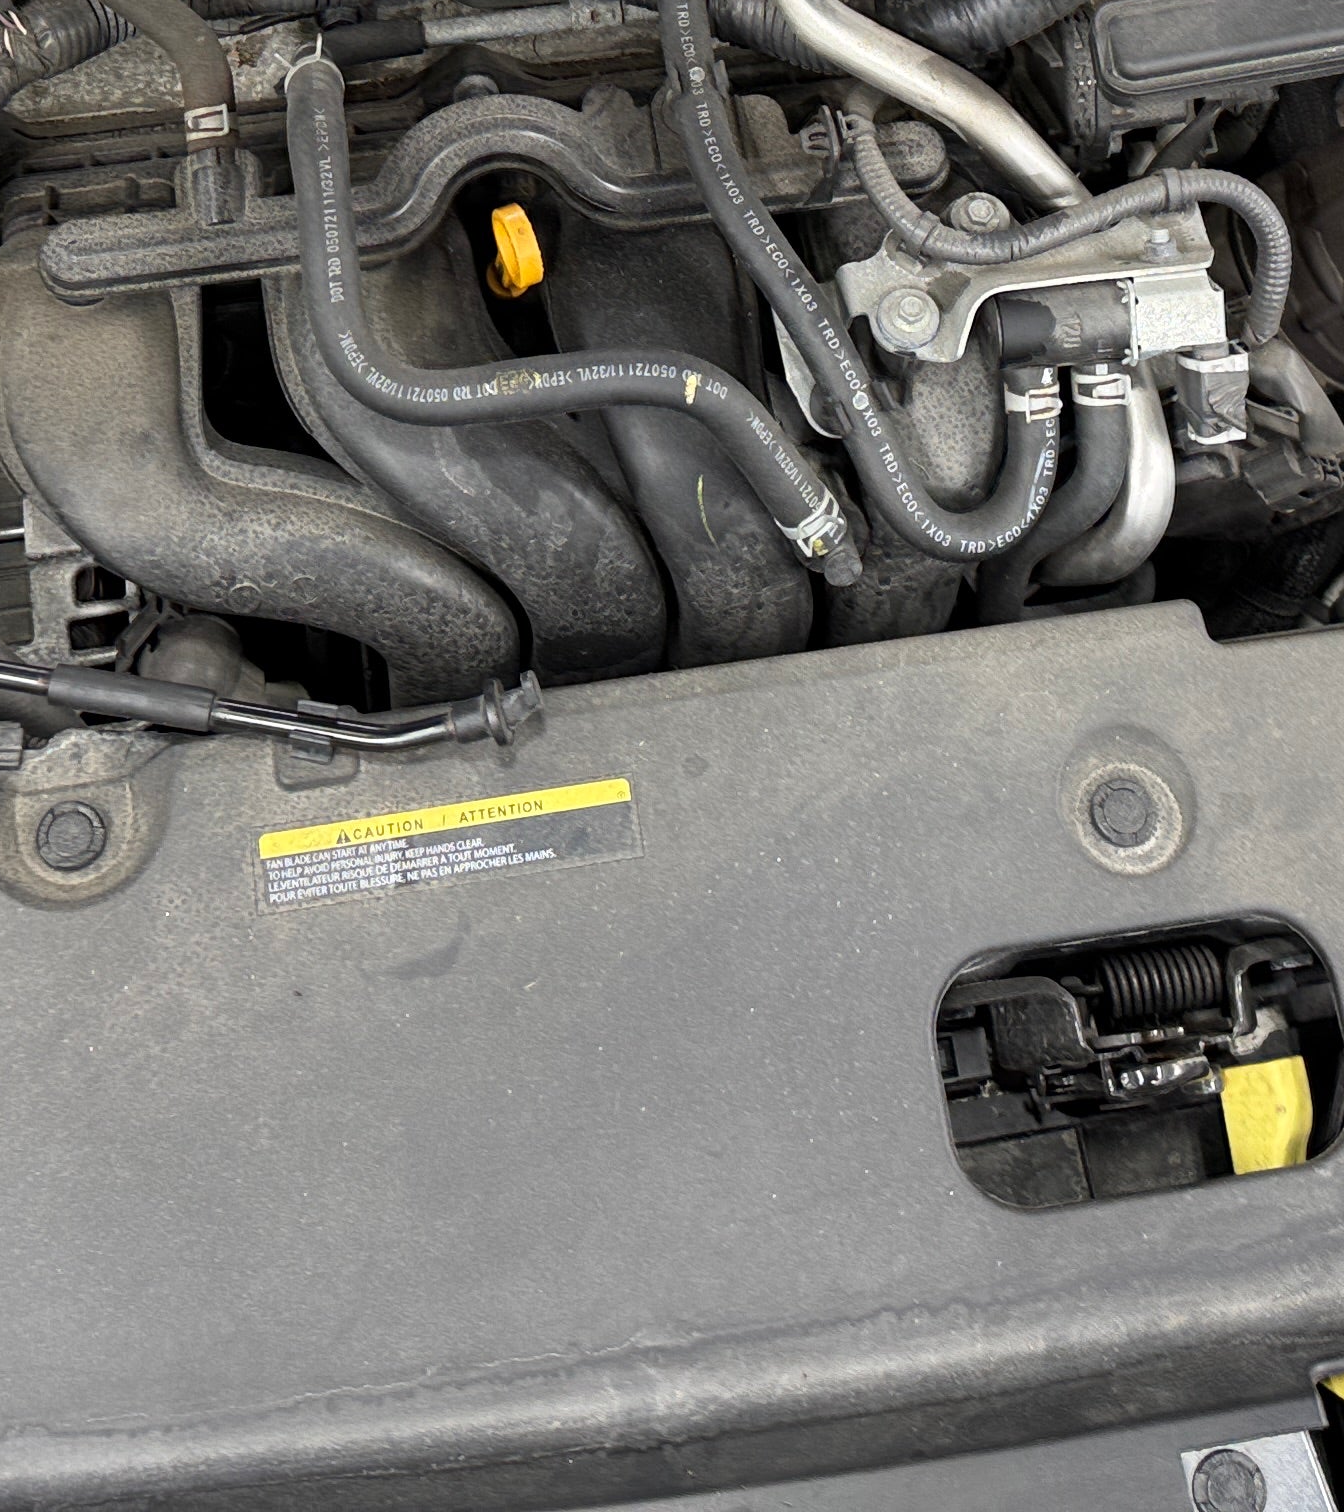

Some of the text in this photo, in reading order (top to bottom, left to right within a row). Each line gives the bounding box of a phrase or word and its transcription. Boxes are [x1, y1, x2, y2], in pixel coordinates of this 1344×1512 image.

[353, 819, 423, 840] CAUTION
[459, 800, 544, 824] ATTENTION
[266, 858, 283, 870] FAN
[284, 855, 311, 868] BLADE
[312, 852, 330, 863] CAN
[331, 847, 357, 859] START
[357, 844, 368, 855] AT
[268, 871, 281, 881] TO
[281, 868, 303, 879] HELP
[304, 863, 330, 876] AVOID
[330, 856, 374, 871] PERSONAL
[404, 847, 425, 859] KEEP
[425, 841, 455, 854] HANDS
[279, 872, 341, 891] VENTILATEUR
[341, 865, 375, 881] RISQUE
[375, 864, 389, 875] DE
[447, 849, 473, 863] TOUT
[269, 890, 297, 904] POUR
[328, 881, 358, 895] TOUTE
[406, 868, 420, 881] NE
[420, 865, 438, 879] PAS
[439, 863, 455, 876] EN
[453, 854, 508, 874] APPROCHER
[508, 851, 524, 865] LES
